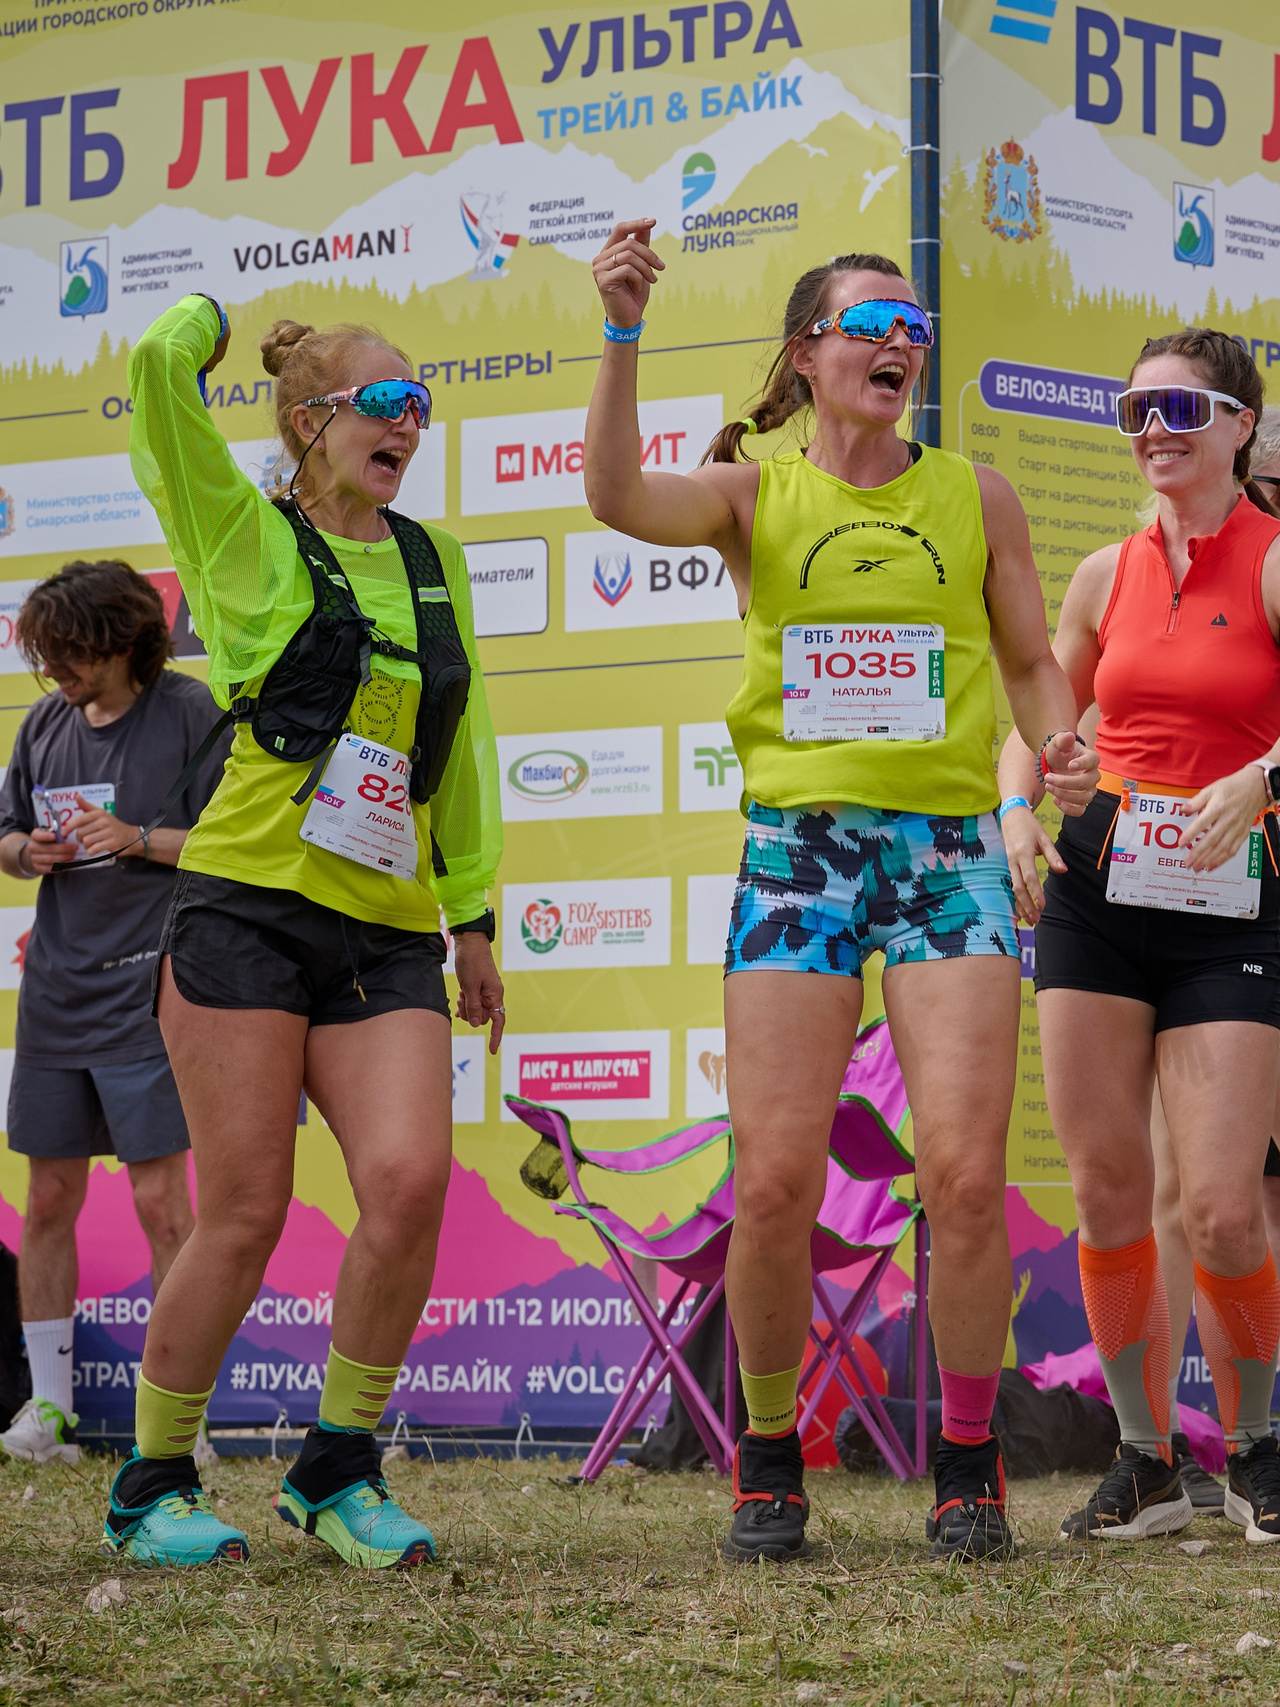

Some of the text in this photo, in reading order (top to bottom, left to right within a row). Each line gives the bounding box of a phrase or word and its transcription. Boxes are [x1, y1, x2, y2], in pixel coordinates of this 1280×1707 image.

[43, 2, 149, 30] ГОРОДСКОГО
[538, 0, 803, 83] УЛЬТРА
[1075, 5, 1226, 148] ВТБ
[536, 72, 803, 140] ТРЕЙЛ & БАЙК
[0, 36, 524, 207] ТБ ЛУКА
[529, 197, 585, 213] ФЕДЕРАЦИЯ
[1045, 195, 1133, 220] МИНИСТЕРСТВО СПОРТА
[529, 211, 614, 230] ЛЕГКОЙ АТЛЕТИКИ
[682, 202, 798, 232] САМАРСКАЯ
[1045, 208, 1126, 231] САМАРСКОЙ ОБЛАСТИ
[529, 228, 612, 246] САМАРСКОЙ ОБЛА
[736, 222, 799, 237] НАЦИОНАЛЬНЫЙ
[1225, 229, 1266, 248] ГОРОДСКОГО
[233, 228, 397, 272] VOLGAMAN
[682, 231, 735, 253] ЛУКА
[736, 238, 755, 248] ПАРК
[122, 247, 192, 266] АДМИНИСТРАЦИЯ
[122, 260, 204, 280] ГОРОДСКОГО ОКРУГА
[616, 330, 640, 340] ЗАБЕ
[419, 351, 552, 384] РТНЕРЫ
[996, 374, 1105, 414] ВЕЛОЗАЕЗД
[971, 423, 1000, 438] 08:00
[1018, 430, 1108, 452] Выдача стартовых
[971, 451, 995, 465] 11:00
[1018, 457, 1046, 473] Старт
[1049, 464, 1062, 474] на
[1063, 465, 1116, 482] дистанции
[1119, 471, 1130, 483] 50
[26, 492, 110, 513] Министерство
[1018, 484, 1130, 510] Старт на дистанции 30
[26, 507, 140, 529] Самарской области
[1027, 513, 1130, 537] тарт на дистанции 15
[1031, 541, 1093, 558] арт дистанц
[921, 538, 945, 584] RUN
[469, 567, 534, 585] иматели
[804, 629, 895, 644] ВТБ ЛУКА
[897, 630, 934, 638] УЛЬТРА
[806, 652, 916, 679] 1035
[932, 652, 940, 696] ТРЕЙЛ
[832, 687, 891, 696] НАТАЛЬЯ
[358, 746, 390, 768] ВТБ
[592, 750, 625, 761] Еда для
[522, 765, 563, 782] Макбио
[591, 764, 650, 777] долгой жизни
[51, 790, 79, 803] ЛУКА
[323, 795, 340, 808] 10 К
[1139, 799, 1165, 814] ВТБ
[365, 811, 405, 833] ЛАРИСА
[1126, 854, 1133, 862] К
[1158, 857, 1187, 869] ЕВГЕ
[1250, 834, 1259, 876] ТРЕЙЛ
[568, 902, 652, 929] FOX SISTERS
[563, 926, 597, 946] CAMP
[521, 1060, 558, 1079] АИСТ
[573, 1058, 639, 1078] КАПУСТА
[551, 1080, 618, 1093] детские игрушки
[1024, 1155, 1068, 1170] Награжд
[73, 1291, 334, 1325] РЯЕВО РСКОЙ
[485, 1298, 543, 1326] 11-12
